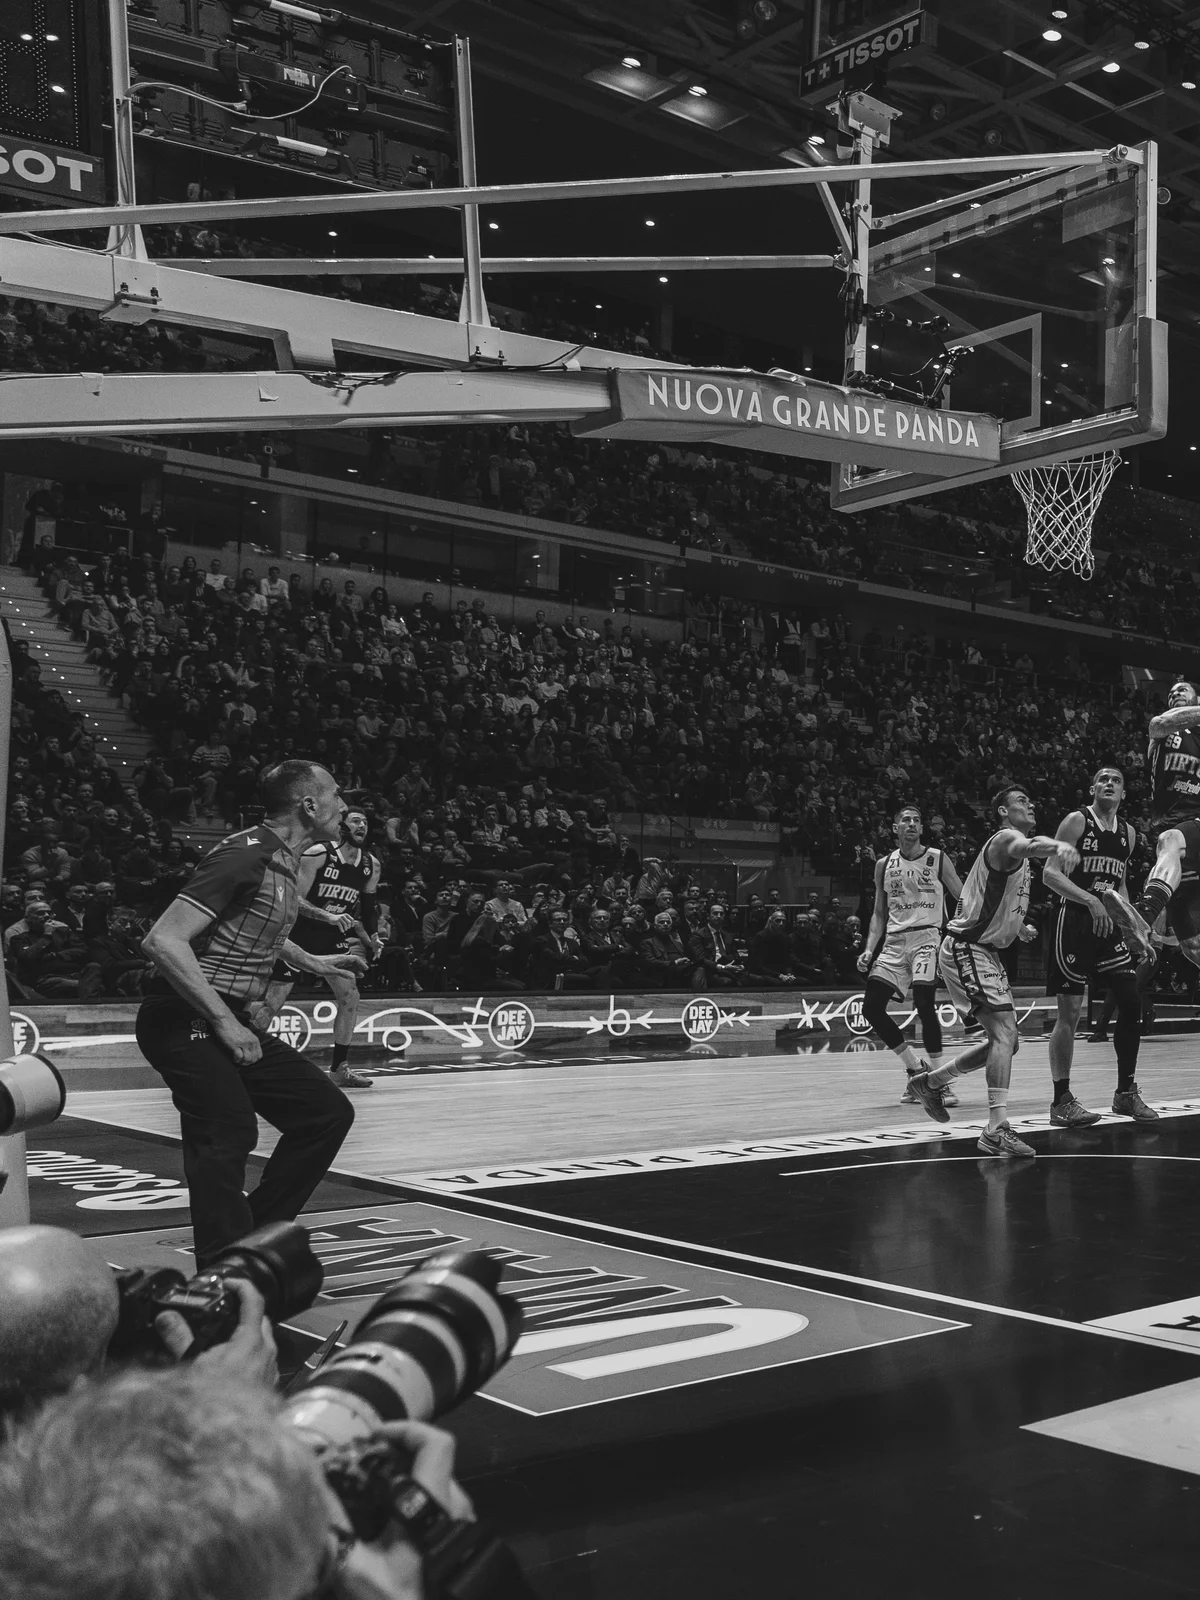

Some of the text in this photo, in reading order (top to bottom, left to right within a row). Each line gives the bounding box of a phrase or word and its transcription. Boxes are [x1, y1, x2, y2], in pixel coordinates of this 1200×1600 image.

[834, 19, 919, 74] TISSOT
[648, 375, 979, 447] NUOVA GRANDE PANDA
[1082, 838, 1098, 851] 24
[889, 858, 899, 868] 21
[1083, 856, 1125, 879] VIRTUS
[323, 867, 339, 880] 00
[317, 883, 360, 903] VIRTUS
[915, 962, 928, 974] 21
[498, 1010, 526, 1025] DEE
[689, 1005, 713, 1019] DEE
[268, 1015, 301, 1034] DEE
[697, 1130, 952, 1159] GRANDE
[429, 1155, 694, 1185] PANDA
